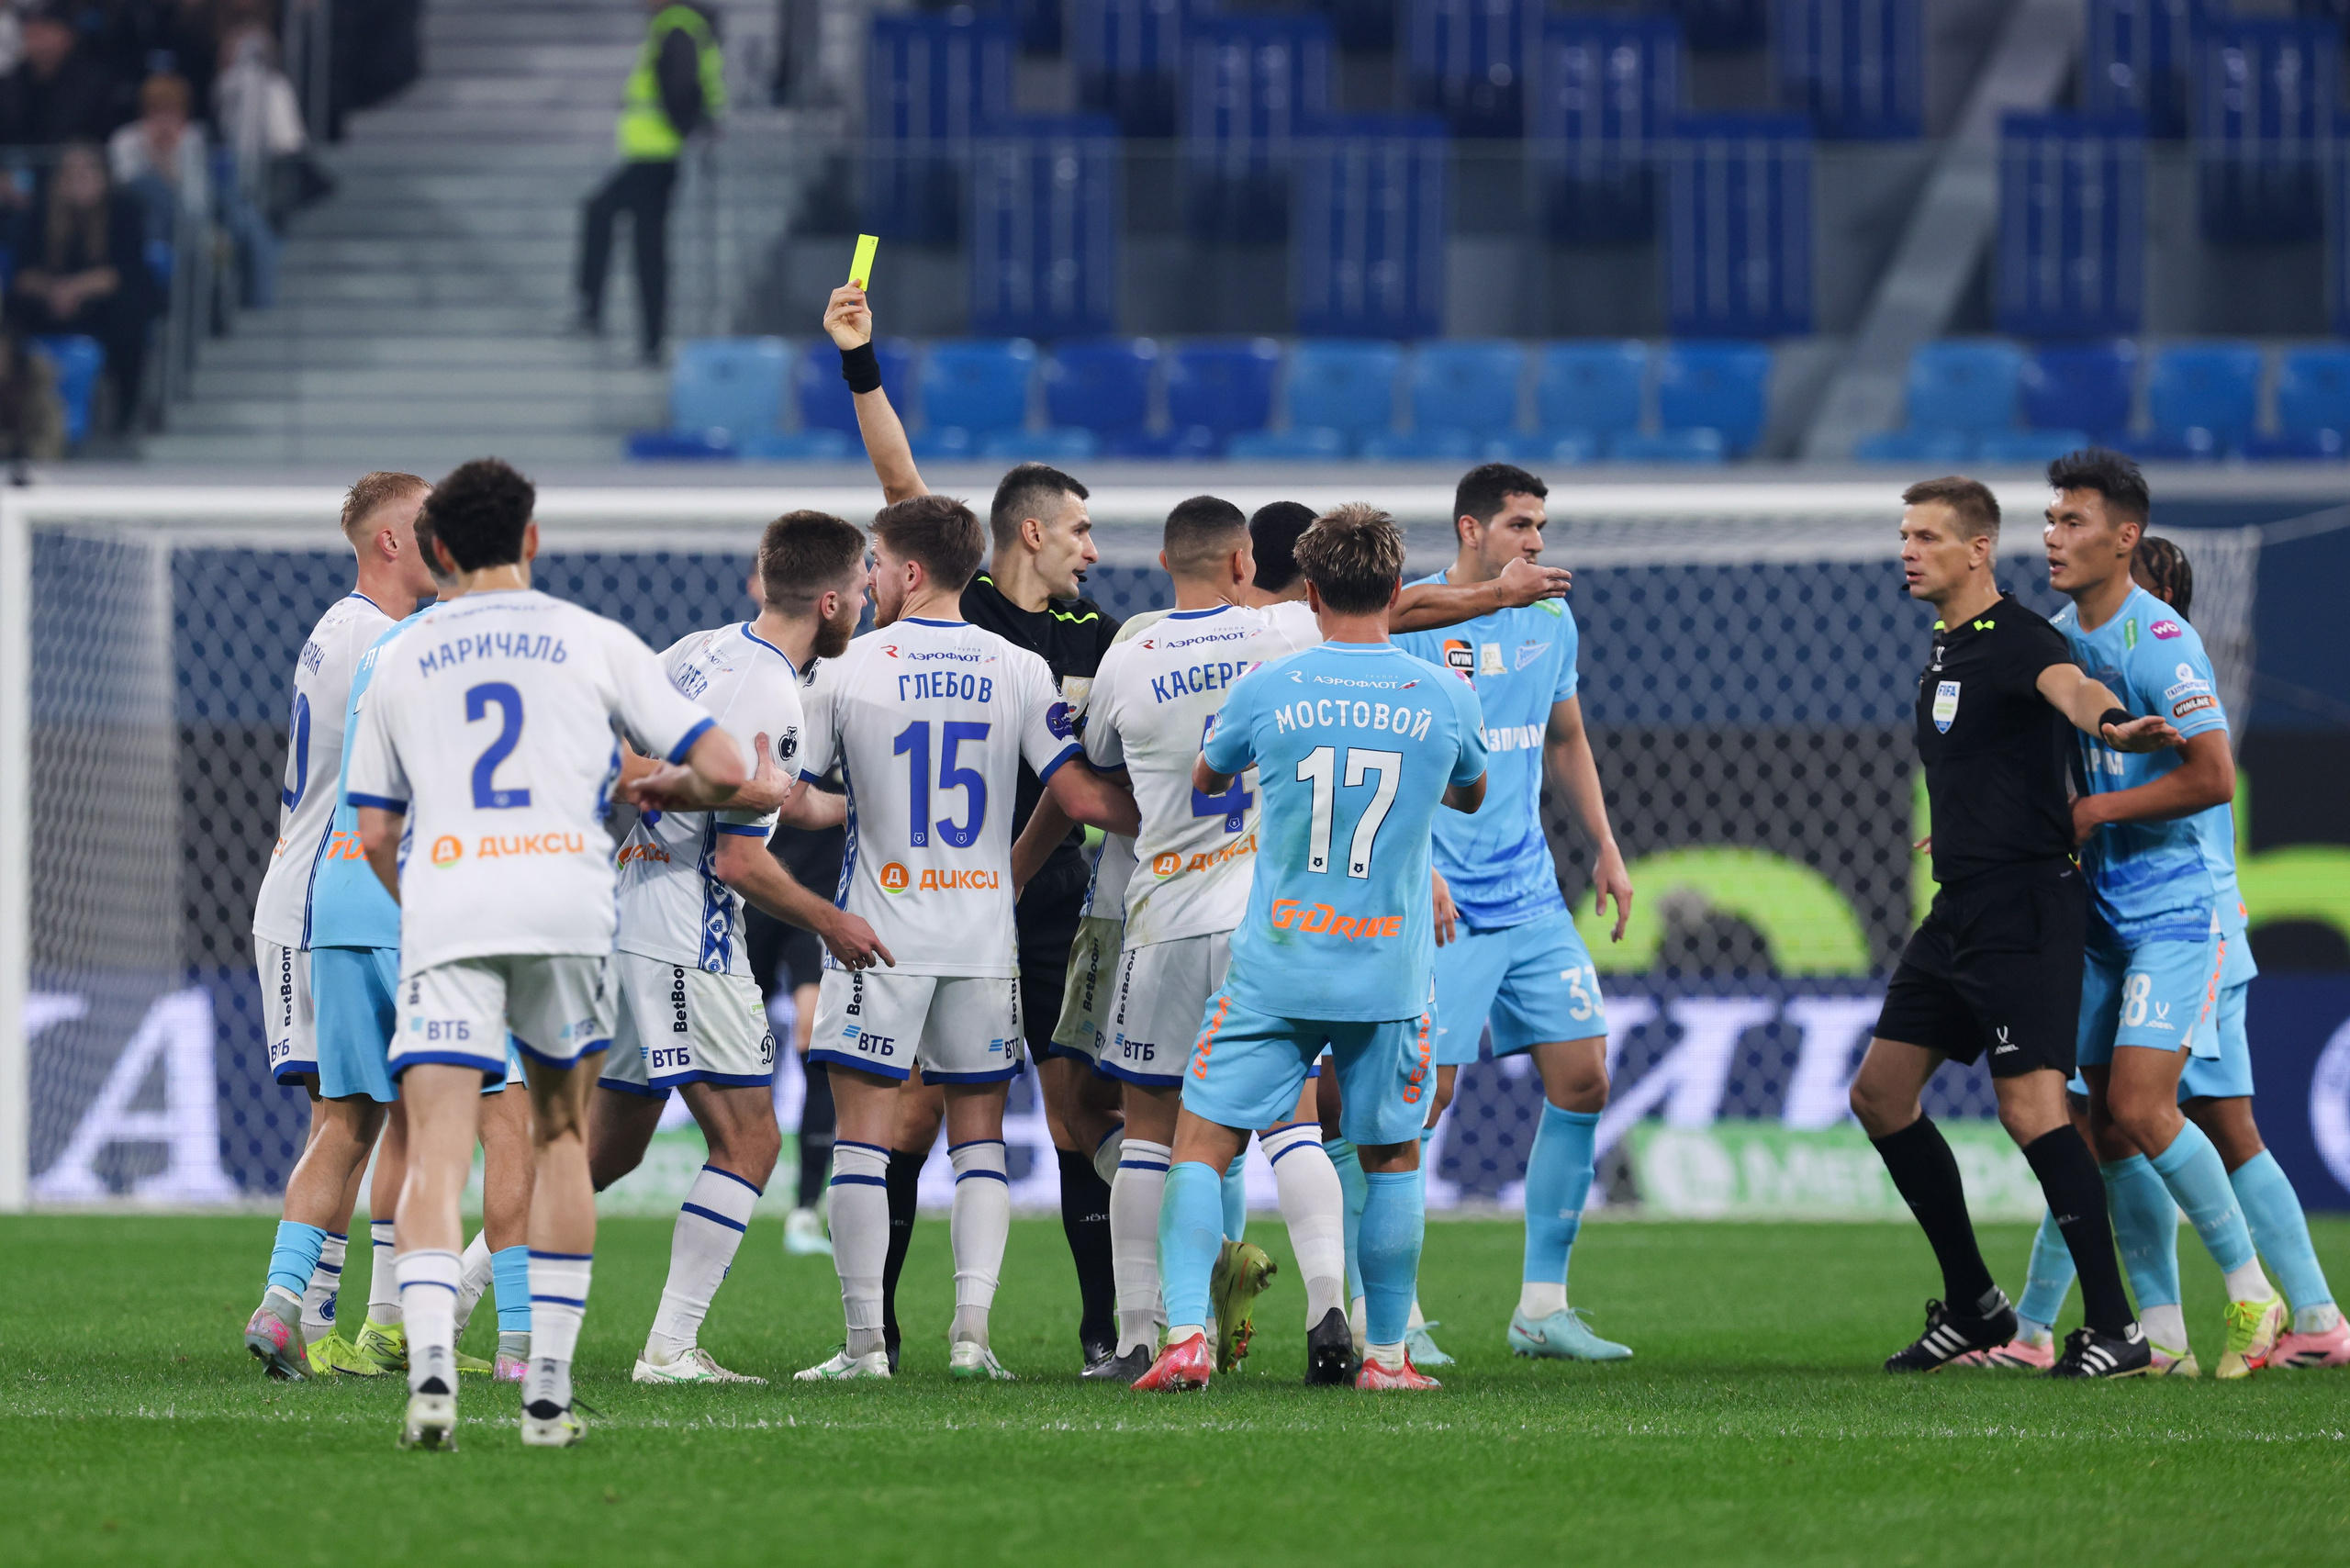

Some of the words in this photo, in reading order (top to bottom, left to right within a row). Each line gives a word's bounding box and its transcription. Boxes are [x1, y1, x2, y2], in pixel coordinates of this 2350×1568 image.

[1166, 631, 1246, 649] АЭРОФЛОТ
[419, 632, 567, 678] МАРИЧАЛЬ
[907, 652, 981, 663] АЭРОФЛОТ
[899, 671, 992, 703] ГЛЕБОВ
[1313, 675, 1398, 689] АЭРОФЛОТ
[1938, 684, 1956, 697] FIFA
[1275, 699, 1432, 742] МОСТОВОЙ
[464, 681, 532, 810] 2
[893, 720, 992, 848] 15
[1191, 714, 1255, 834] 4
[1295, 745, 1404, 879] 17
[671, 964, 688, 1033] BetBoo
[846, 971, 863, 1016] BetB
[428, 1020, 470, 1040] ВТБ
[858, 1032, 895, 1056] ВТБ
[270, 1037, 290, 1063] ВТБ
[652, 1047, 690, 1069] ВТБ
[1124, 1039, 1155, 1061] ВТБ
